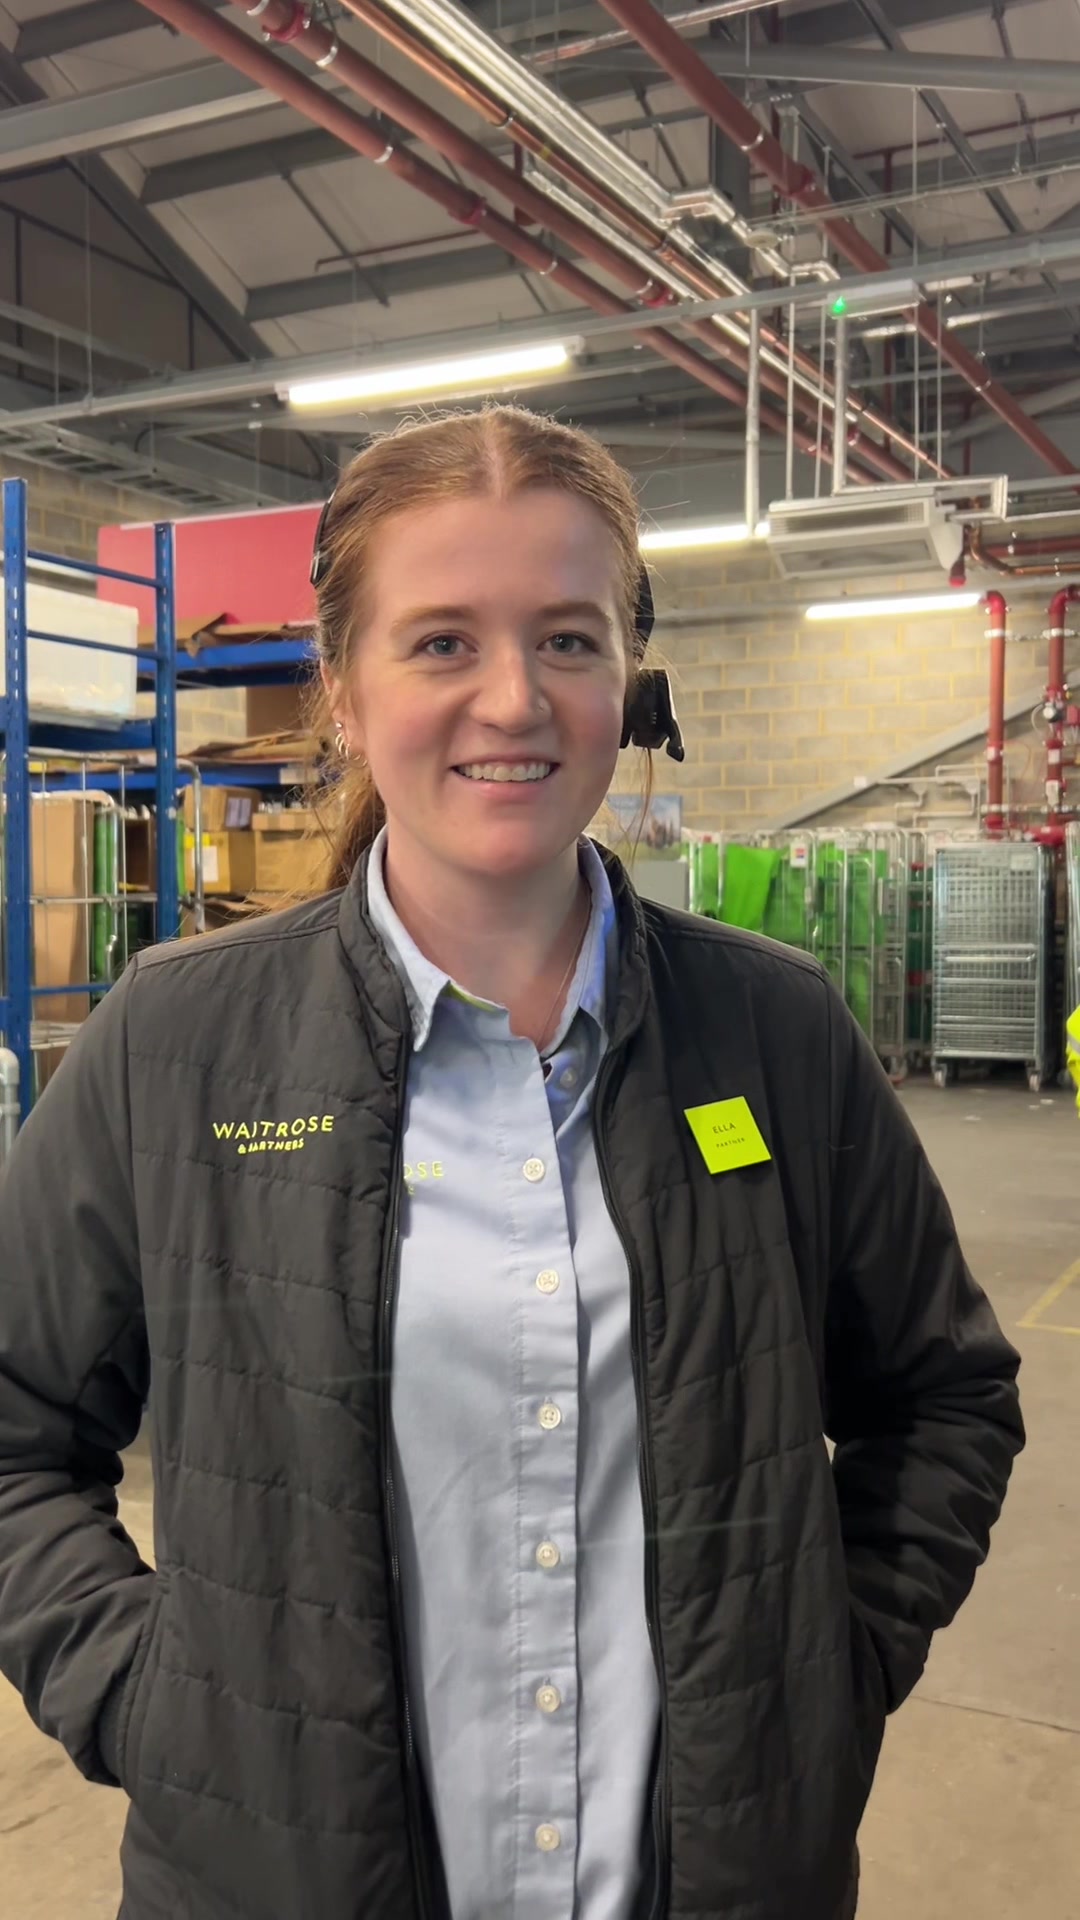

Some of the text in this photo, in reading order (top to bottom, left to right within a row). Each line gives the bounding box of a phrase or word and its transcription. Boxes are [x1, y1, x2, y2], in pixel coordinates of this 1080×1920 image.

[212, 1115, 335, 1139] WAITROSE
[712, 1122, 736, 1134] ELLA
[237, 1143, 247, 1155] &
